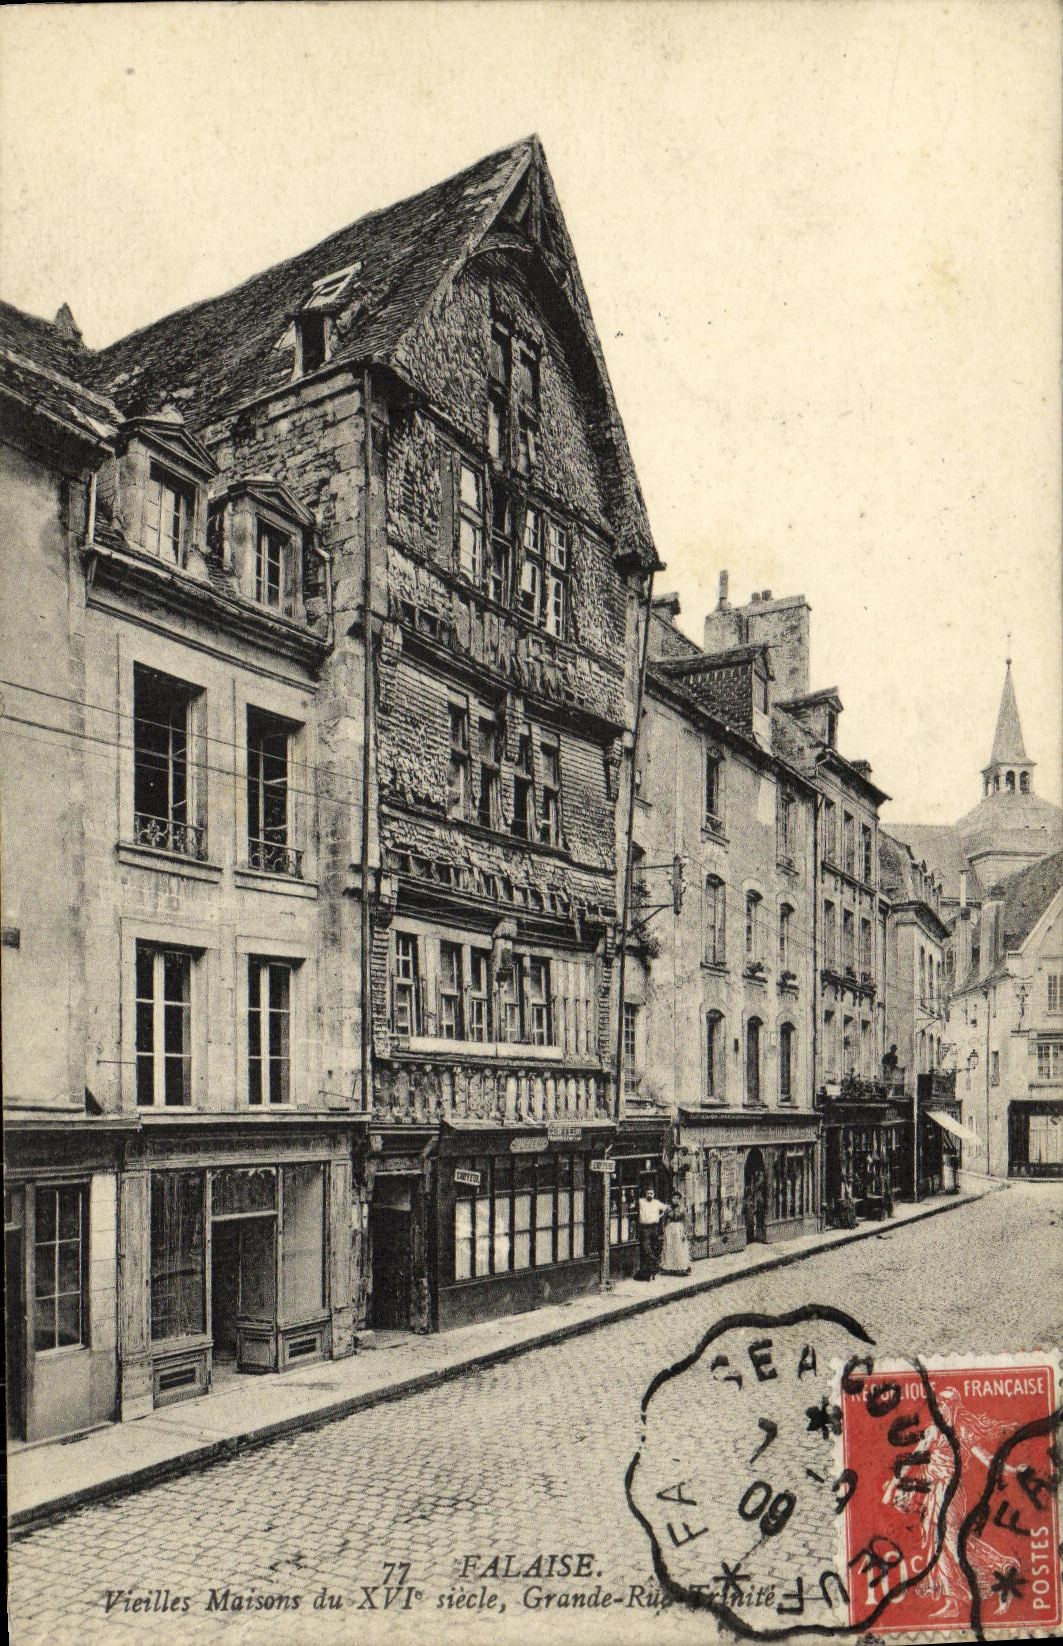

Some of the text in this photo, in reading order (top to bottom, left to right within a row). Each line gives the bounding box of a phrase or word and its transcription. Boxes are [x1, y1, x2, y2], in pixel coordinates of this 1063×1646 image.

[963, 1377, 1045, 1398] FRANÇAISE
[737, 1480, 797, 1537] 09
[1032, 1525, 1050, 1609] POSTES
